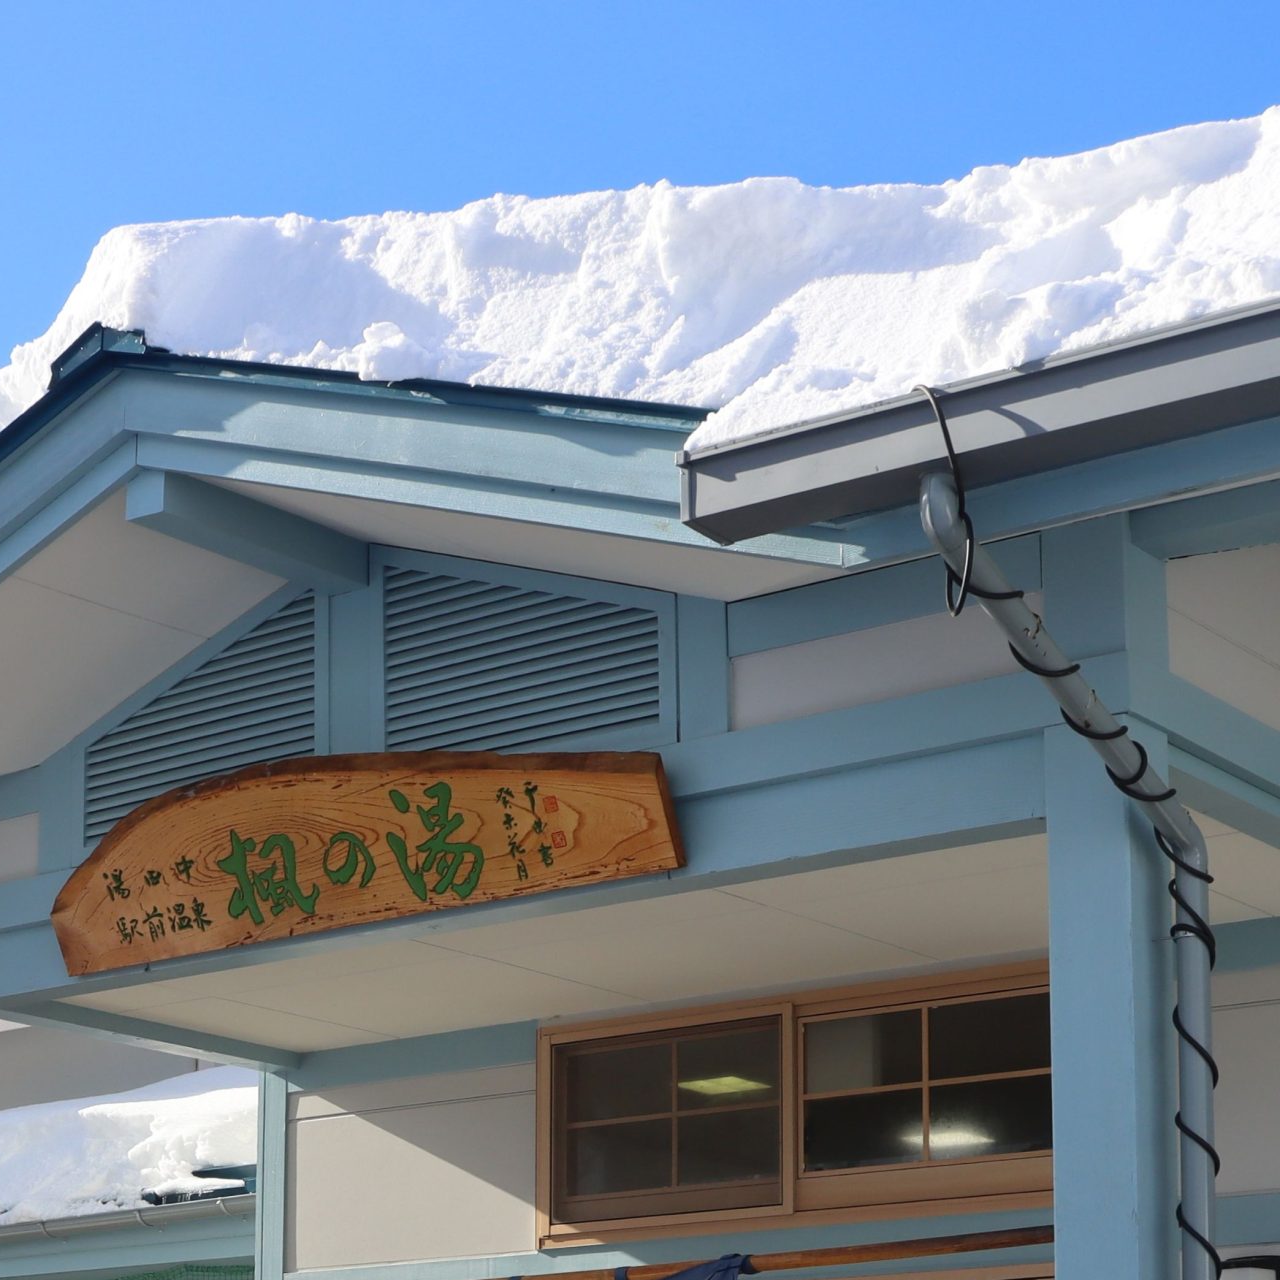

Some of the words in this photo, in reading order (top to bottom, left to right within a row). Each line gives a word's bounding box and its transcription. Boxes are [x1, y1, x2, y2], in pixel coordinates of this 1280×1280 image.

[217, 781, 485, 924] 楓の湯
[115, 897, 213, 945] 駅前温泉
